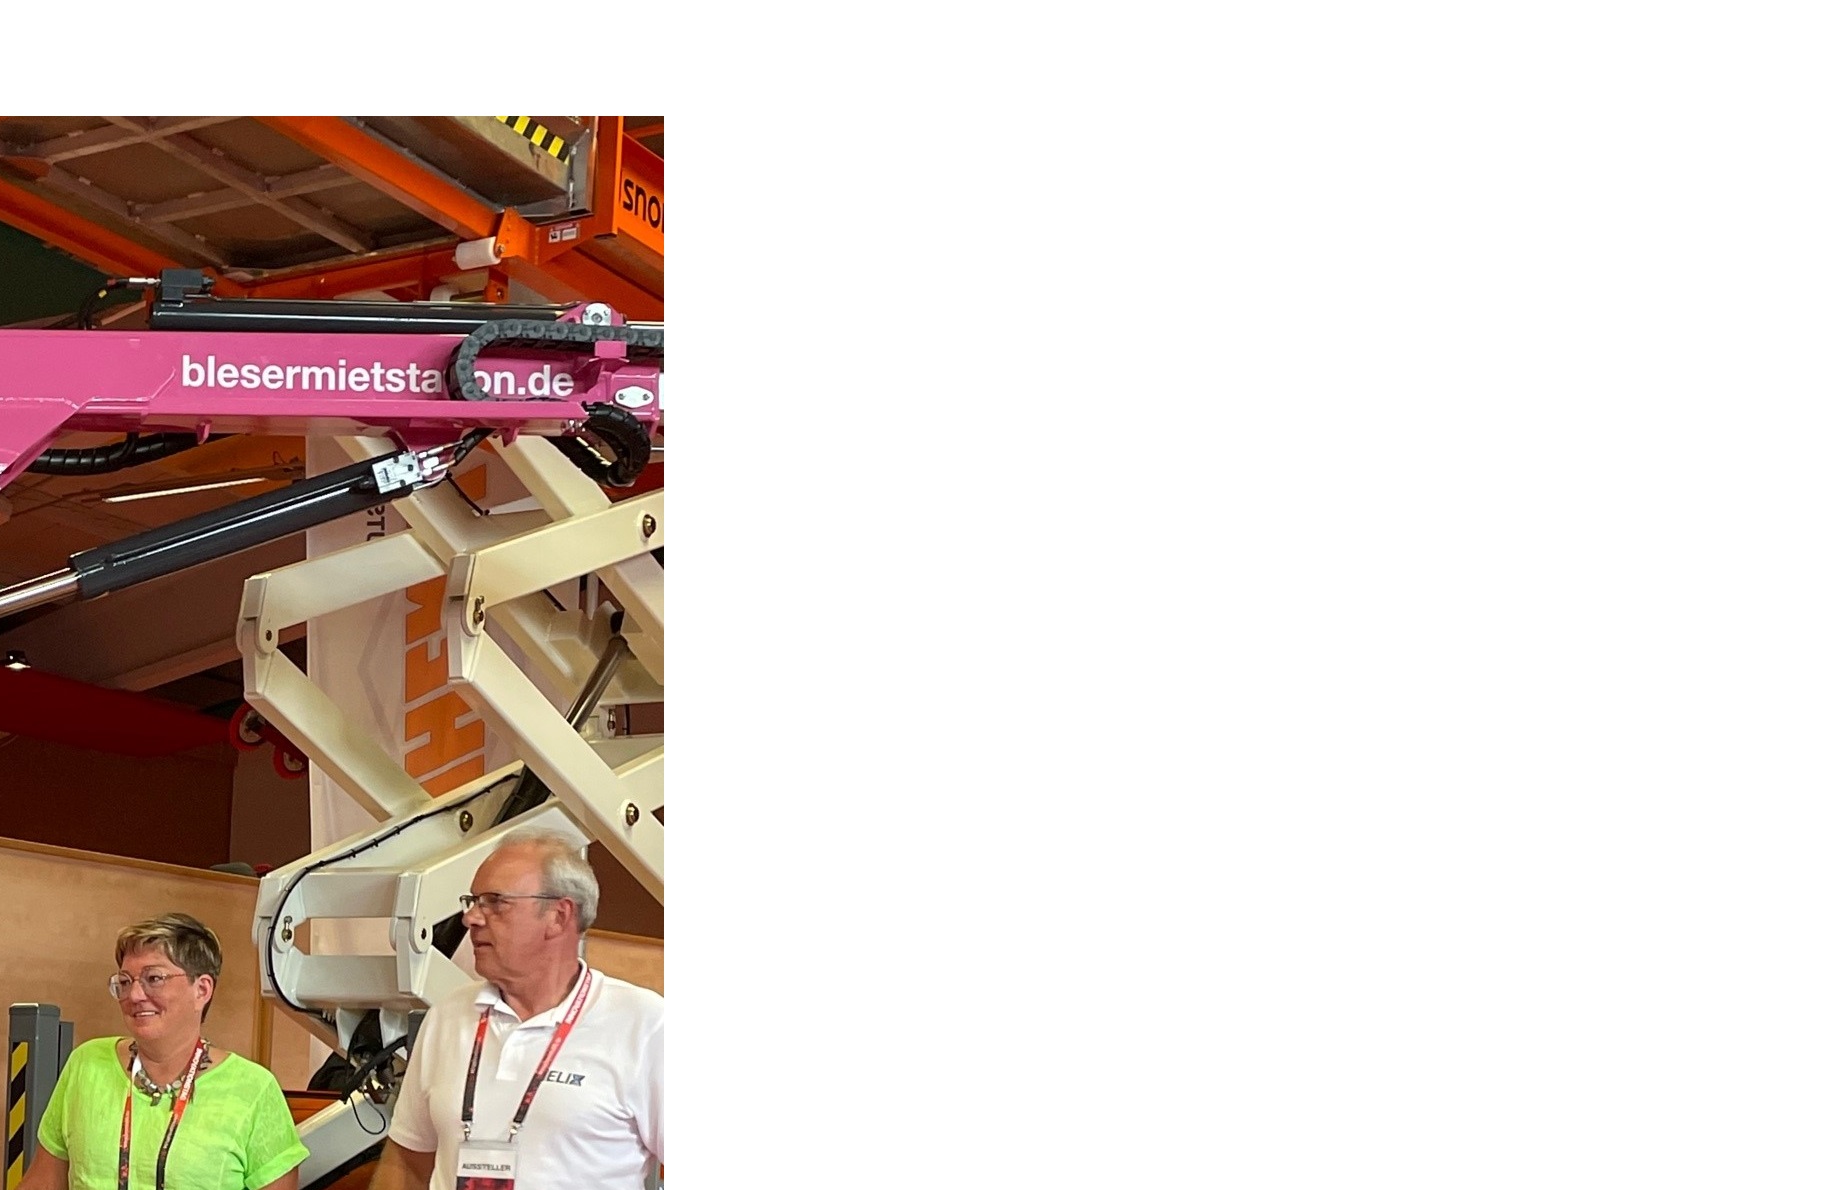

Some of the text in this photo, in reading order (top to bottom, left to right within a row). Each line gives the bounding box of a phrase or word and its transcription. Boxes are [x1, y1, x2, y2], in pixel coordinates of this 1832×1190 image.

[623, 179, 664, 233] sno
[182, 354, 575, 397] blesermietstaon.de
[547, 1070, 585, 1087] ELIX
[462, 1163, 511, 1172] AUSSTELLER
